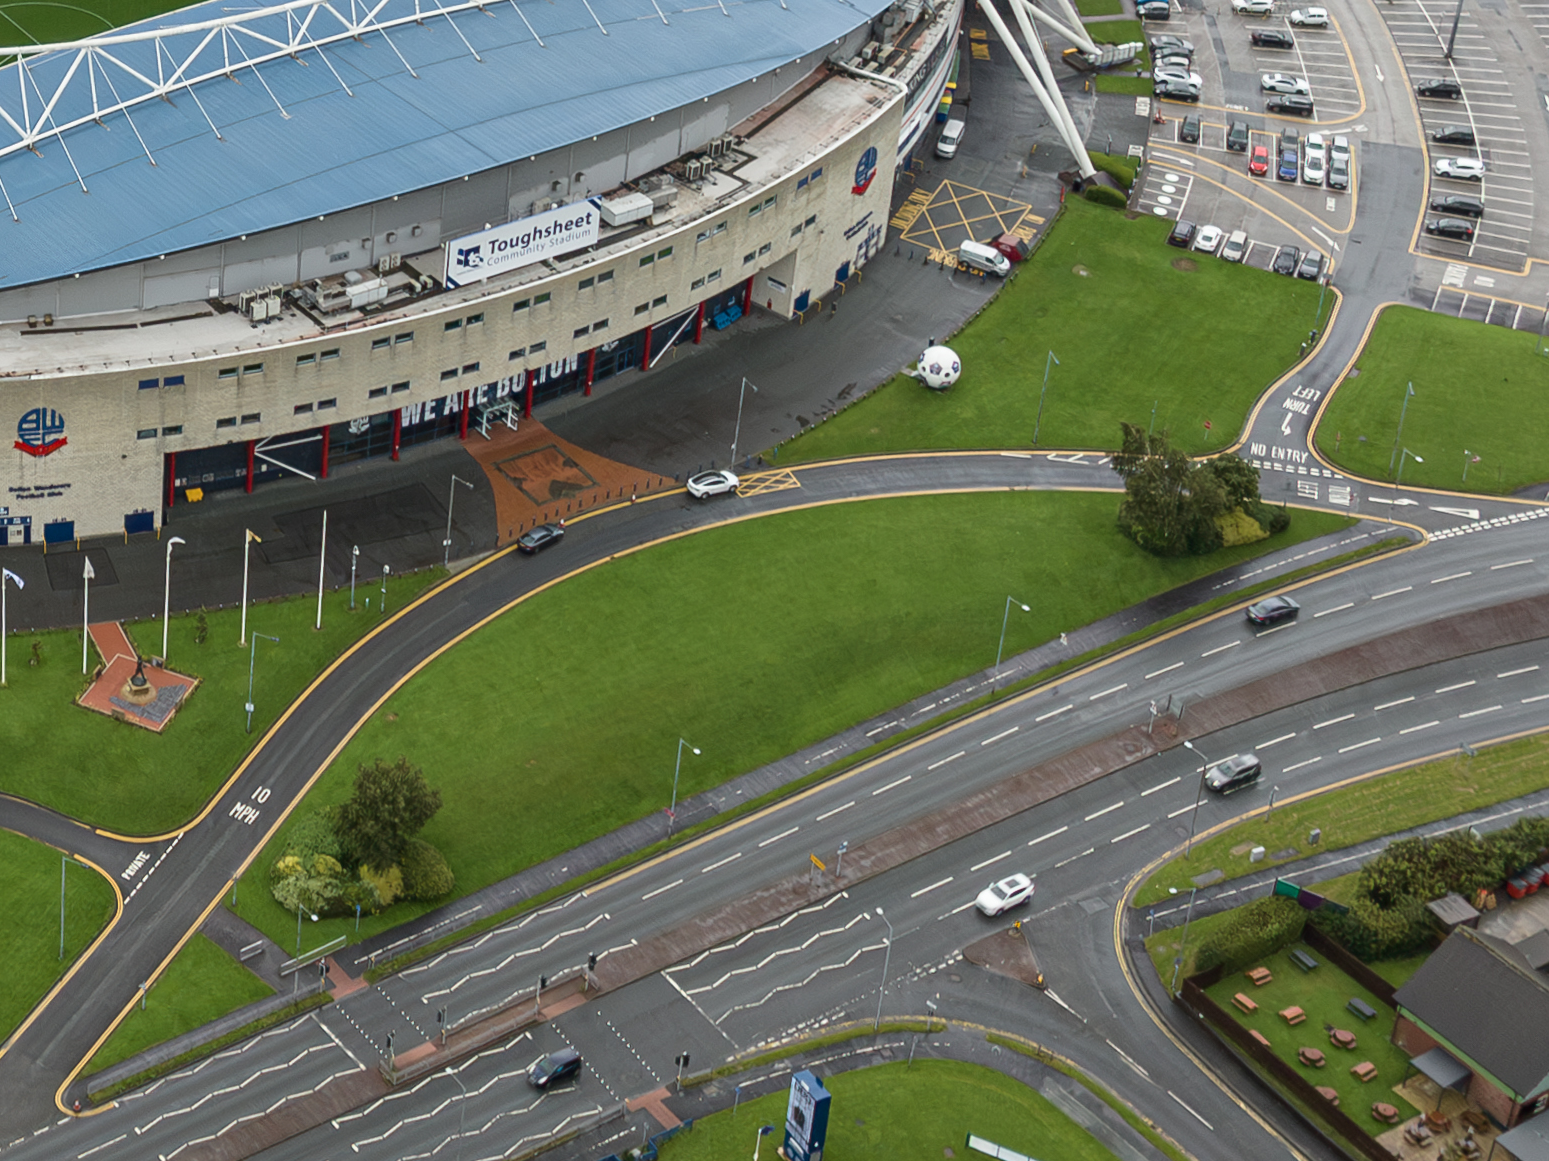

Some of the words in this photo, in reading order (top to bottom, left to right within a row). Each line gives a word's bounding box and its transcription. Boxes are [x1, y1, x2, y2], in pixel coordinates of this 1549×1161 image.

[488, 212, 592, 255] Toughsheet
[487, 242, 546, 267] Community
[549, 229, 591, 247] Stadium
[1292, 385, 1321, 402] LEFT
[401, 399, 437, 428] WE
[1282, 397, 1311, 415] TURN
[1250, 442, 1267, 457] NO
[1271, 446, 1309, 464] ENTRY
[251, 785, 272, 804] 10
[228, 801, 260, 825] MPH
[121, 850, 151, 881] PRIVATE
